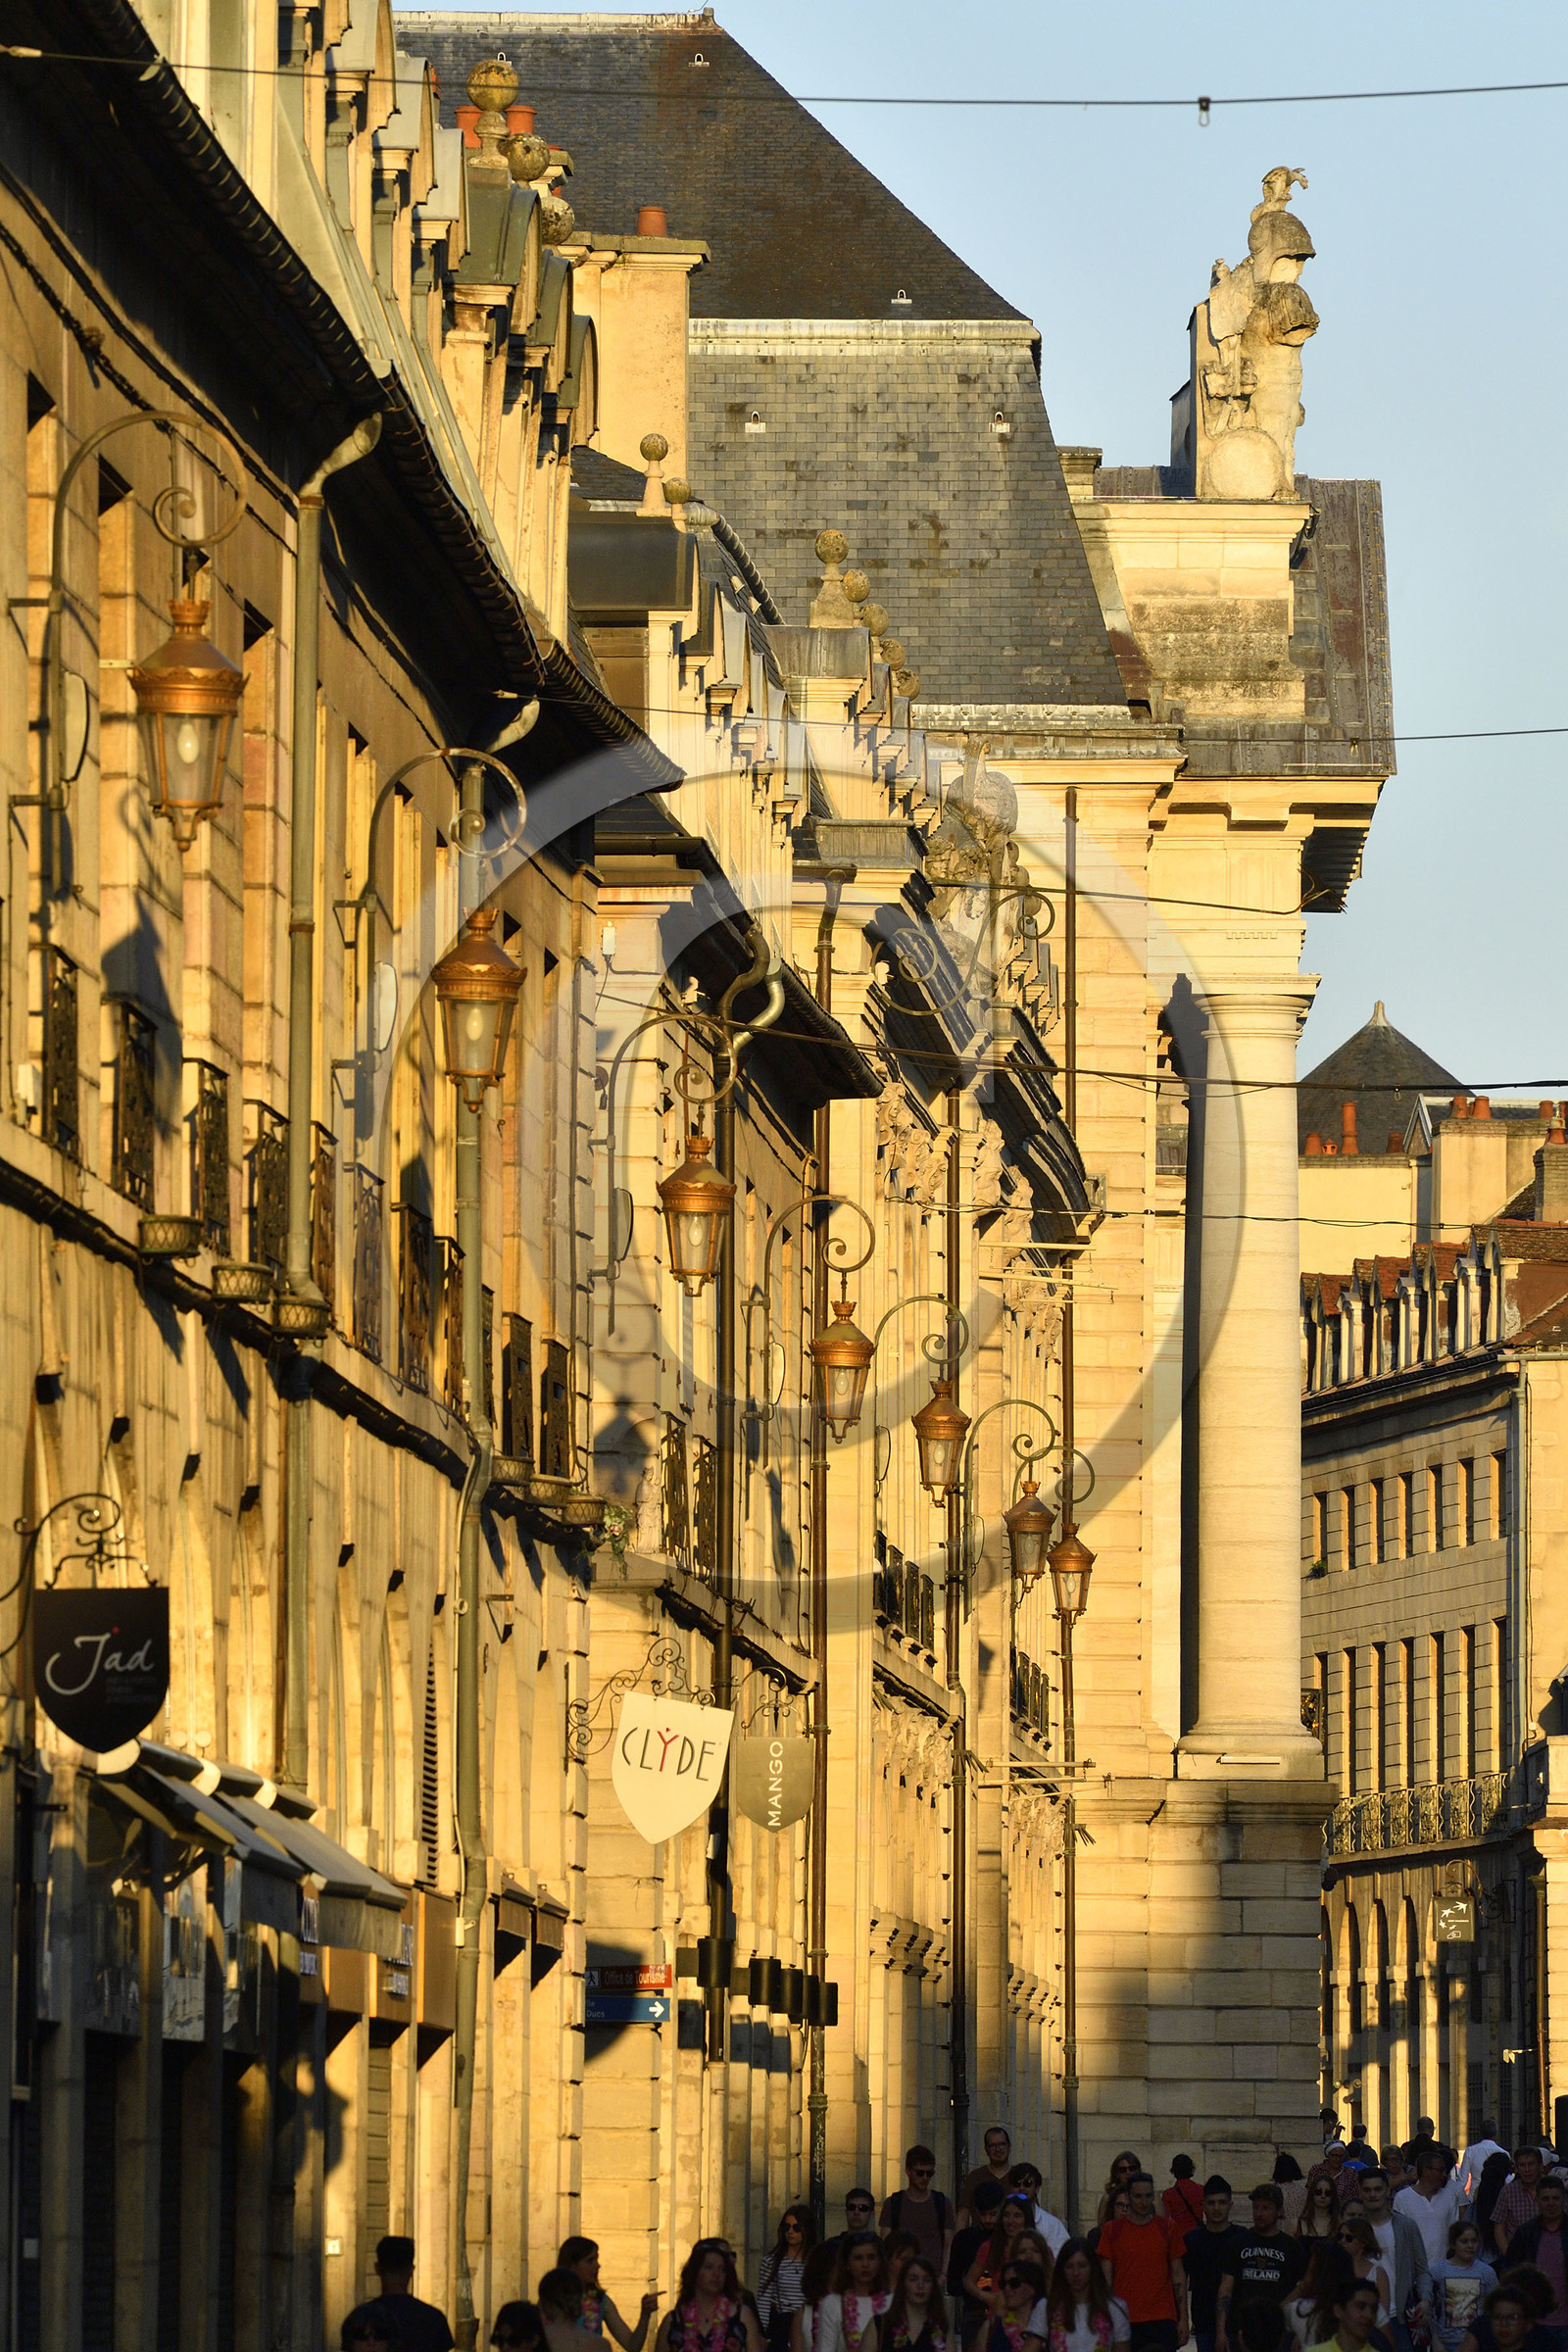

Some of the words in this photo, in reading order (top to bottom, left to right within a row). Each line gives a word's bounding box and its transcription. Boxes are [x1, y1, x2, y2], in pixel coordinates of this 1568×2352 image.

[45, 1630, 156, 1696] Jad
[621, 1727, 716, 1782] CLYDE
[767, 1740, 784, 1827] MANGO
[604, 1970, 623, 1984] Office
[625, 1970, 633, 1984] de
[634, 1970, 666, 1984] Tourisme
[1240, 2246, 1286, 2263] GUINNESS
